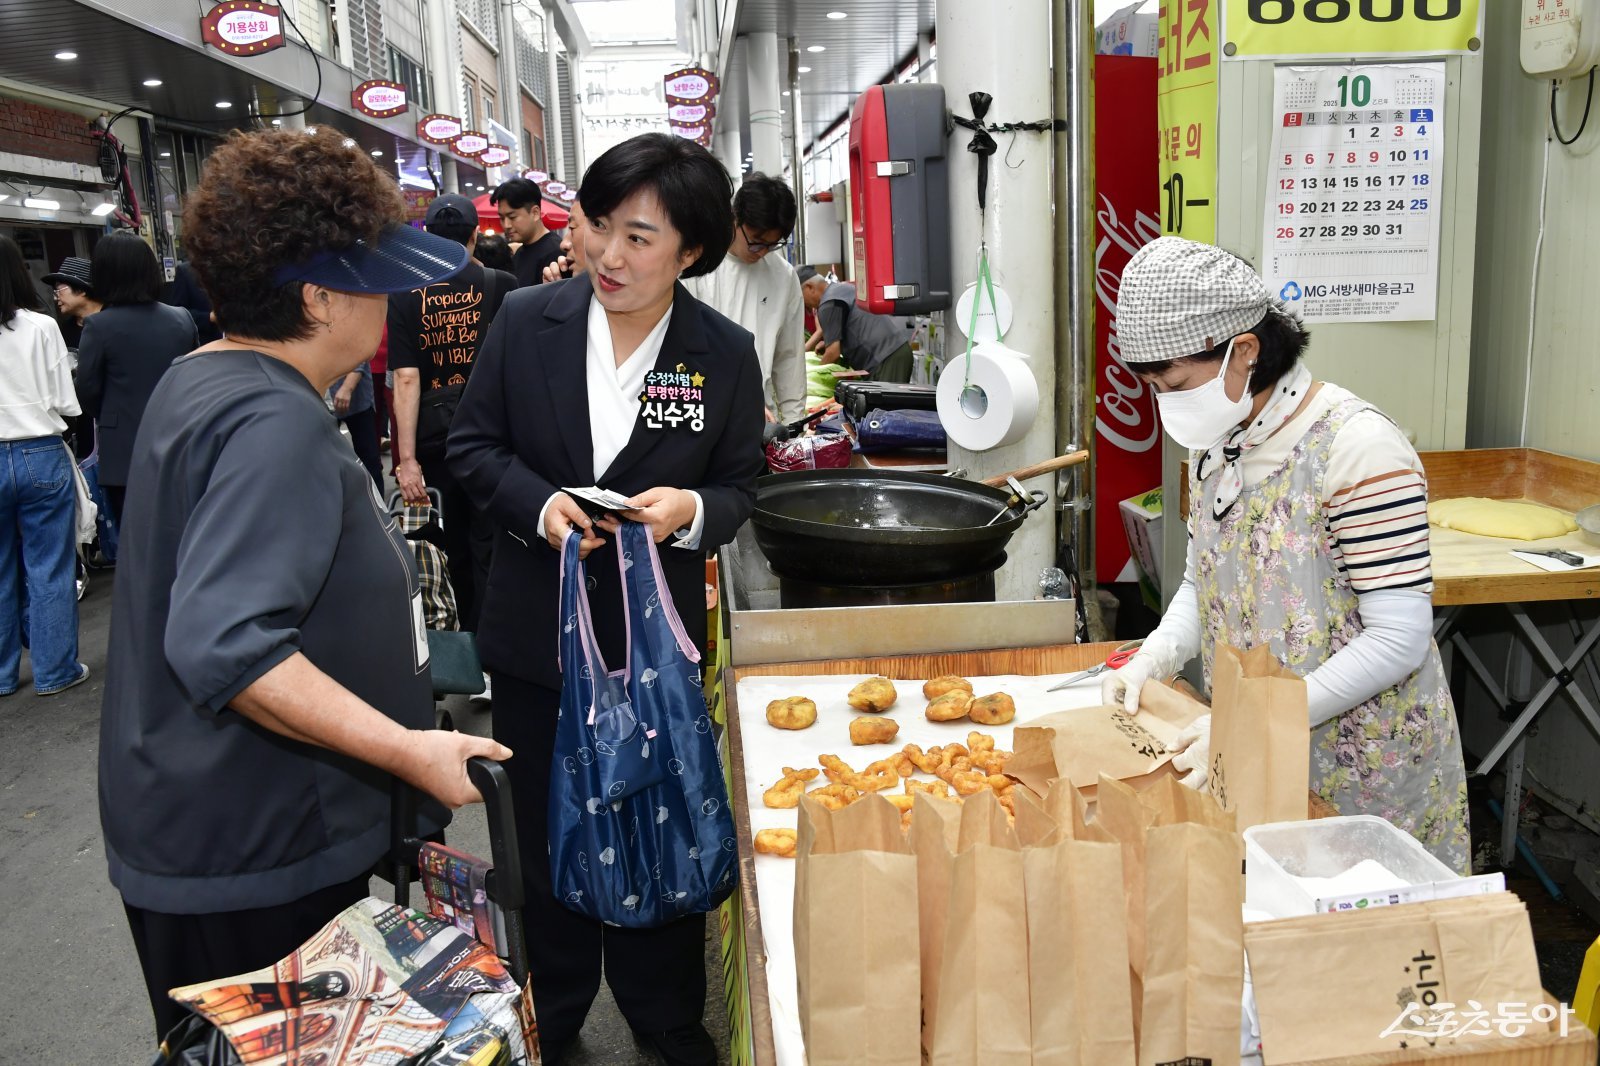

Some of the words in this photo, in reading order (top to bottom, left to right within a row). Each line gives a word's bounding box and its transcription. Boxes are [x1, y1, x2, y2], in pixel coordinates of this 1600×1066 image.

[226, 21, 268, 33] 기용상회
[1337, 74, 1371, 108] 10
[1289, 113, 1297, 122] 日
[1307, 112, 1315, 122] 月
[1328, 112, 1337, 121] 火
[1347, 112, 1358, 121] 水
[1371, 111, 1381, 120] 木
[1394, 110, 1404, 119] 金
[1417, 109, 1426, 119] 土
[1349, 128, 1354, 138] 1
[1371, 127, 1379, 137] 2
[1394, 126, 1403, 136] 3
[1417, 125, 1426, 135] 4
[1285, 154, 1292, 165] 5
[1305, 154, 1314, 164] 6
[1328, 153, 1334, 163] 7
[1347, 153, 1355, 163] 8
[1370, 152, 1378, 162] 9
[1390, 150, 1406, 161] 10
[1414, 150, 1428, 160] 11
[1280, 179, 1294, 189] 12
[1301, 178, 1317, 188] 13
[1323, 178, 1336, 188] 14
[1343, 177, 1358, 187] 15
[1365, 176, 1381, 186] 16
[1389, 175, 1405, 186] 17
[1412, 174, 1429, 185] 18
[1279, 203, 1294, 214] 19
[1300, 202, 1317, 213] 20
[1321, 202, 1335, 212] 21
[1342, 201, 1358, 212] 22
[1364, 201, 1381, 211] 23
[1387, 200, 1405, 210] 24
[1410, 199, 1428, 210] 25
[1277, 228, 1294, 238] 26
[1299, 227, 1315, 237] 27
[1320, 226, 1336, 237] 28
[1341, 225, 1358, 236] 29
[1363, 225, 1380, 235] 30
[1386, 224, 1401, 235] 31
[1304, 285, 1327, 297] MG
[1329, 282, 1415, 296] 서방새마을금고
[411, 283, 483, 314] Tropical
[646, 372, 690, 387] 수정처럼
[647, 386, 702, 401] 투명한정치
[641, 402, 705, 432] 신수정
